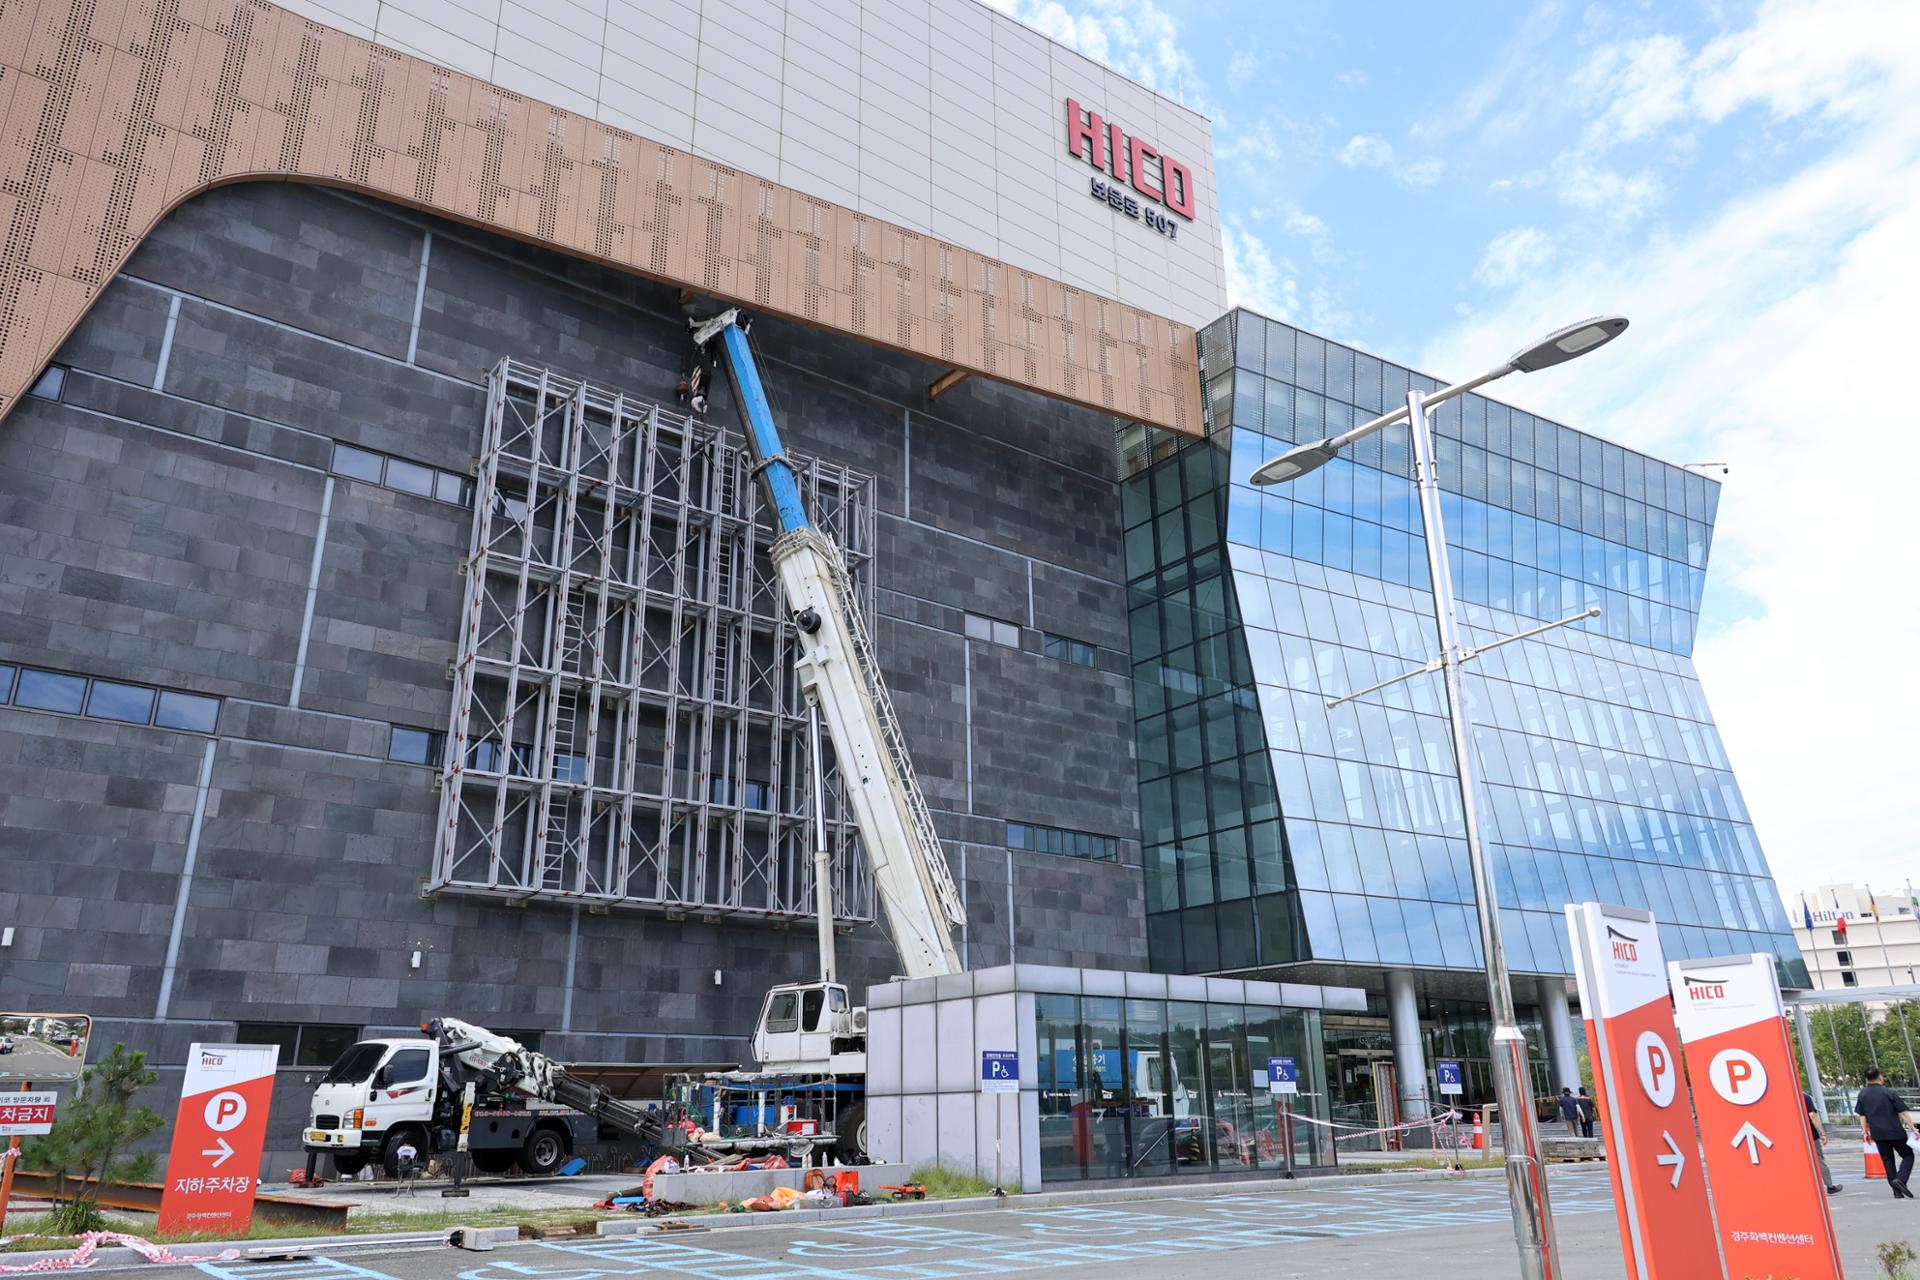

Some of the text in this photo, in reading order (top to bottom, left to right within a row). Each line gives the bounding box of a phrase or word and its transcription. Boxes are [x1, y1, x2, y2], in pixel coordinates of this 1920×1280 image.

[1067, 97, 1195, 220] HICO
[1091, 177, 1178, 238] 보문로 507
[1612, 941, 1638, 962] HICO
[1689, 985, 1725, 1000] HICO
[201, 1057, 223, 1066] HICO
[992, 1061, 1000, 1078] P
[1647, 1045, 1666, 1091] P
[1276, 1066, 1283, 1080] P
[1726, 1060, 1752, 1093] P
[216, 1099, 238, 1125] P
[174, 1176, 250, 1194] 지하주차장
[1730, 1231, 1815, 1246] 경주화백컨벤션센터
